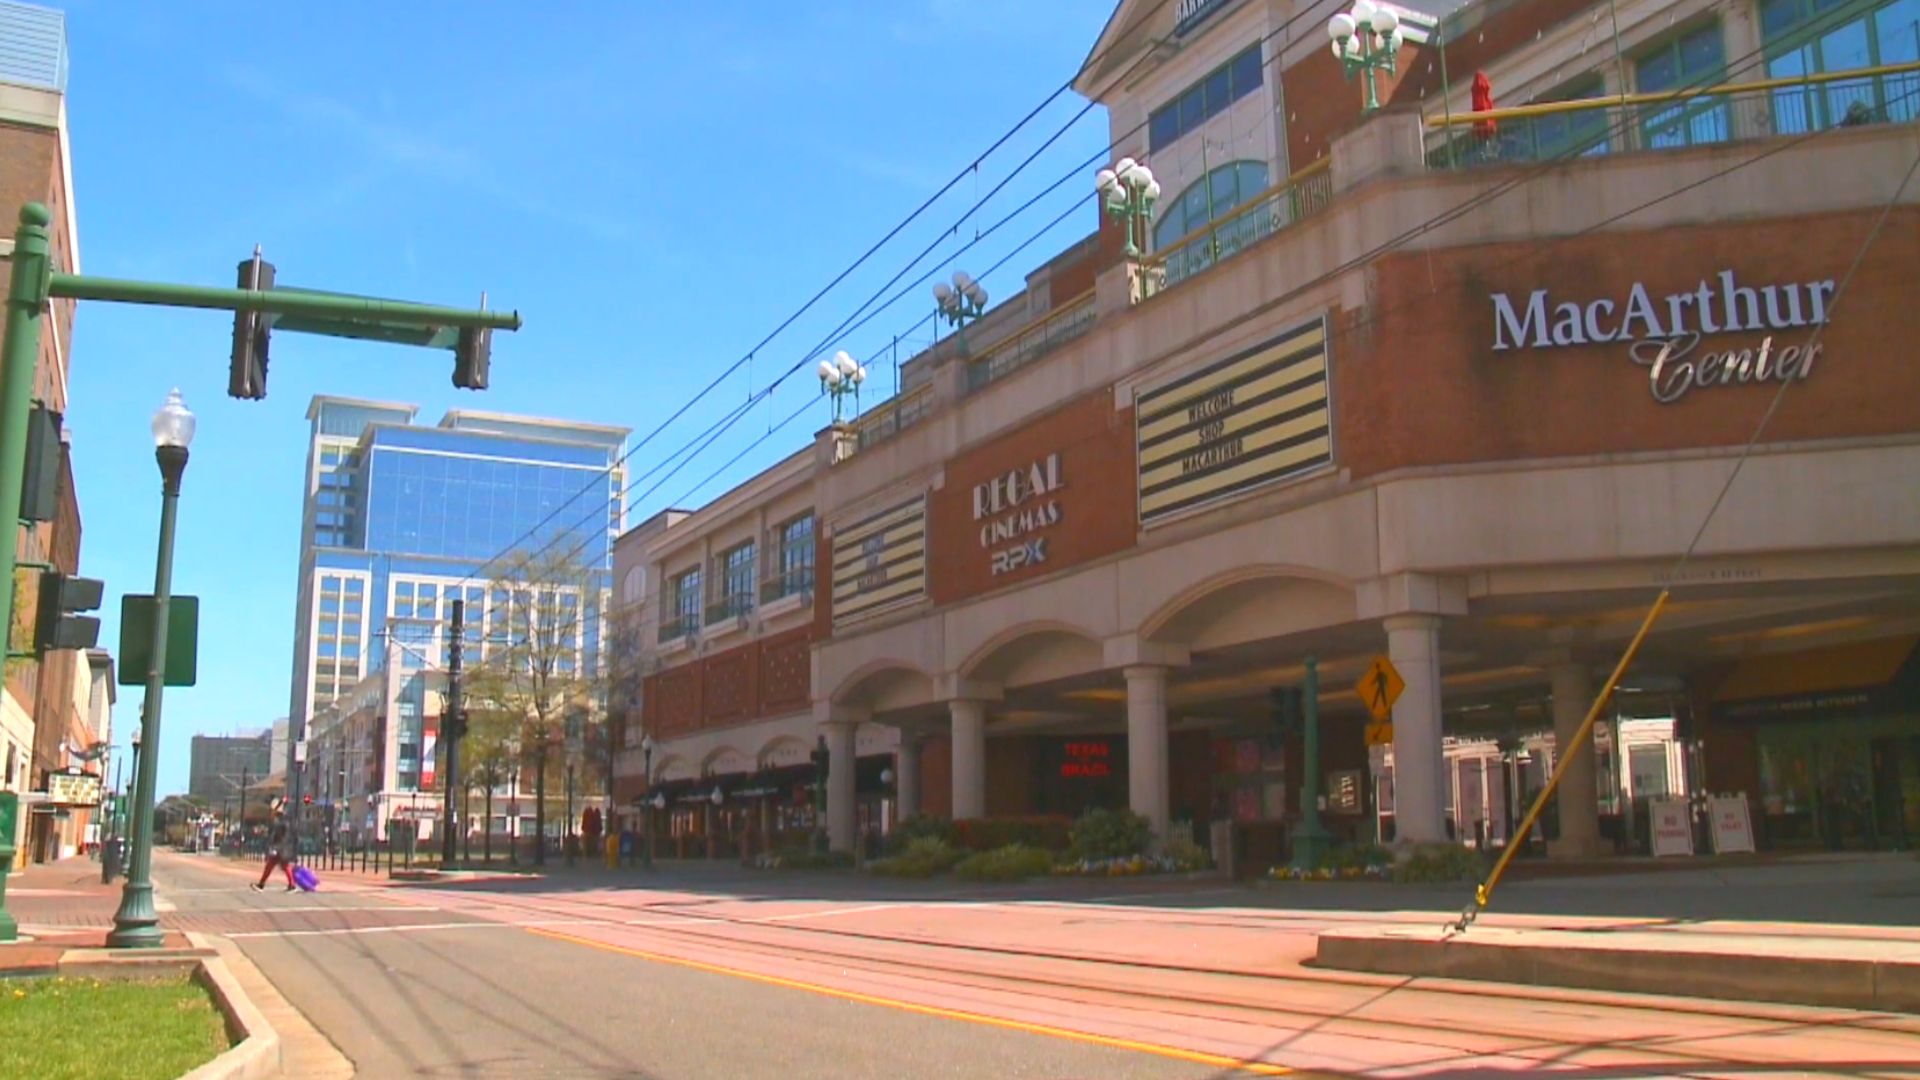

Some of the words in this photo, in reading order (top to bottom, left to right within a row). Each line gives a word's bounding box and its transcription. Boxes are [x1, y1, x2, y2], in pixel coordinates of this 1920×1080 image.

[1490, 269, 1835, 352] MacArthur
[1630, 332, 1823, 403] Center
[1188, 390, 1235, 423] WELCOME
[1199, 420, 1225, 444] SHOP
[1182, 439, 1244, 475] MACARTHUR
[973, 453, 1065, 521] REGAL
[980, 499, 1060, 549] CINEMAS
[991, 537, 1047, 577] RPX
